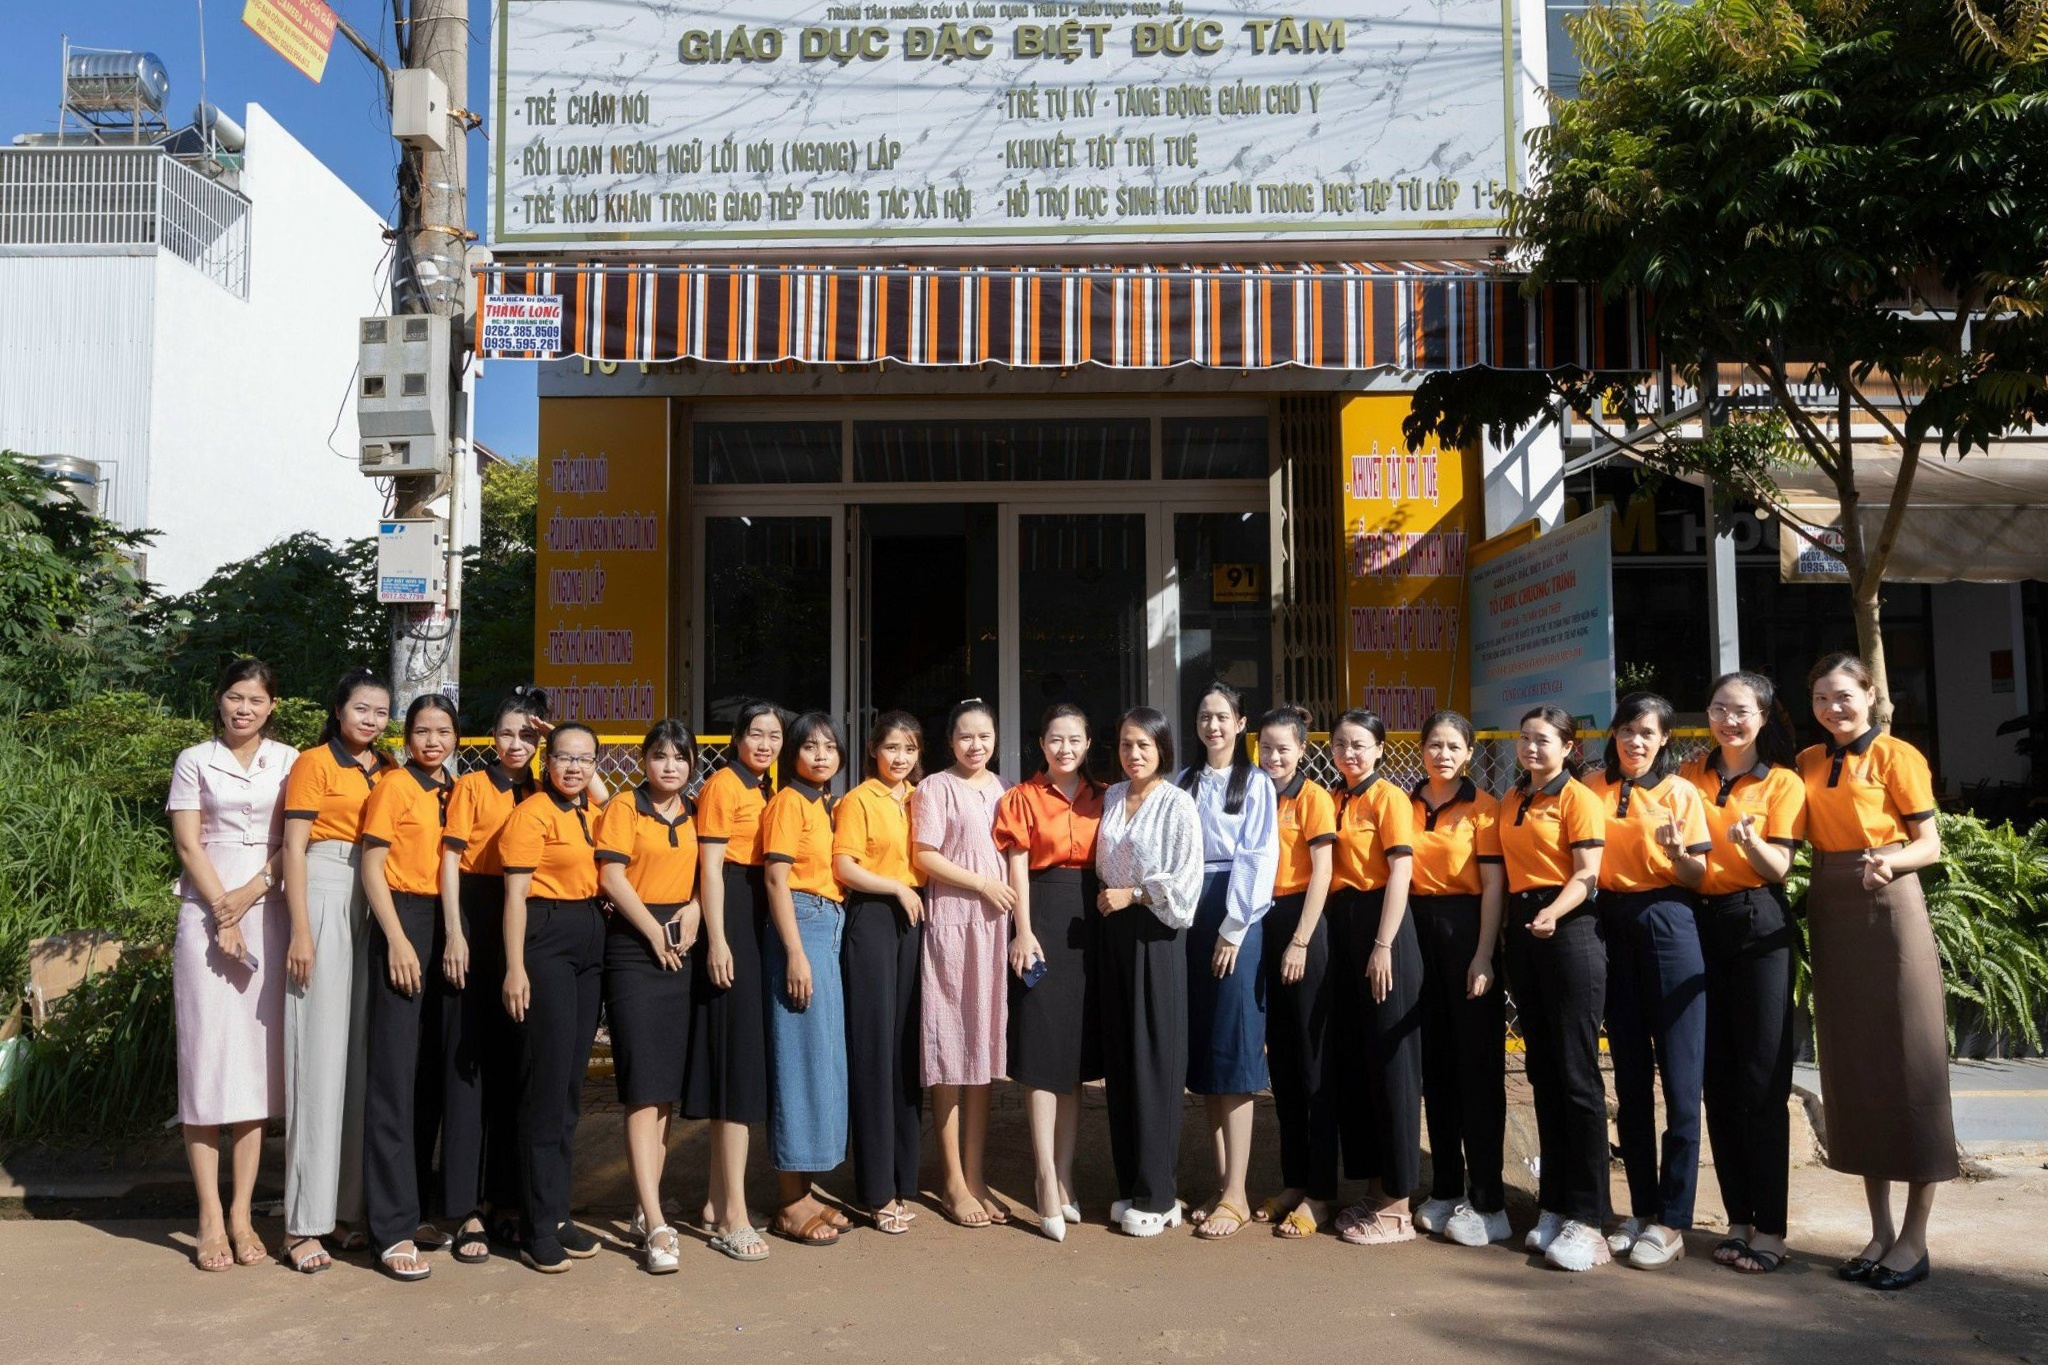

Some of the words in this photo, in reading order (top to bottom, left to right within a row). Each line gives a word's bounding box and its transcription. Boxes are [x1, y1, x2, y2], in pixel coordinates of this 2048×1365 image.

[303, 19, 314, 32] AN
[827, 5, 862, 21] TRUNG
[864, 4, 888, 20] TÂM
[890, 3, 929, 20] NGHIÊN
[930, 1, 953, 19] CỨU
[955, 2, 970, 19] VÀ
[1000, 4, 1029, 21] DỤNG
[1104, 3, 1129, 19] DỤC
[678, 24, 784, 65] GIÁO
[799, 26, 890, 68] DỤC
[903, 22, 994, 66] ĐẶC
[1013, 19, 1113, 65] BIỆT
[1131, 15, 1224, 58] ĐỨC
[1241, 15, 1346, 56] TÂM
[525, 88, 557, 126] TRẺ
[567, 90, 617, 127] CHẬM
[621, 90, 650, 125] NÓI
[1006, 79, 1040, 120] TRẺ
[1114, 83, 1161, 118] TĂNG
[1166, 83, 1213, 119] ĐỘNG
[1218, 77, 1262, 116] GIẢM
[1266, 80, 1302, 116] CHÚ
[1308, 80, 1322, 115] Ý
[523, 136, 552, 177] RỐI
[557, 144, 603, 178] LOẠN
[610, 140, 658, 176] NGÔN
[666, 137, 704, 175] NGỮ
[745, 138, 774, 174] NÓI
[782, 139, 858, 175] (NGỌNG)
[866, 133, 902, 172] LẮP
[1006, 129, 1077, 169] KHUYẾT
[1085, 133, 1118, 170] TẬT
[1124, 132, 1156, 168] TRÍ
[1163, 131, 1199, 169] TUỆ
[522, 185, 557, 224] TRẺ
[562, 188, 598, 224] KHÓ
[604, 189, 652, 224] KHĂN
[659, 190, 717, 223] TRONG
[722, 190, 763, 222] GIAO
[767, 182, 805, 222] TIẾP
[877, 186, 911, 220] TÁC
[913, 185, 939, 220] XÃ
[944, 186, 972, 222] HỘI
[1006, 179, 1031, 218] HỖ
[1035, 183, 1071, 221] TRỢ
[1074, 185, 1109, 220] HỌC
[1116, 185, 1159, 217] SINH
[1163, 179, 1201, 217] KHÓ
[1205, 180, 1254, 216] KHĂN
[1256, 181, 1316, 214] TRONG
[1322, 181, 1356, 216] HỌC
[1360, 177, 1394, 216] TẬP
[1397, 176, 1423, 211] TỪ
[1426, 175, 1462, 212] LỚP
[1471, 178, 1499, 210] 1-5
[485, 325, 559, 338] 0262.385.8509
[486, 303, 525, 318] THĂNG
[528, 305, 560, 318] LONG
[484, 337, 559, 350] 0935.595.261
[1634, 384, 1731, 415] GARAE
[552, 450, 569, 493] TRẺ
[568, 453, 592, 499] CHẬM
[593, 452, 609, 493] NÓI
[1351, 440, 1383, 499] KHUYẾT
[1386, 447, 1402, 507] TẬT
[1422, 447, 1439, 507] TUỆ
[564, 516, 587, 558] LOẠN
[586, 512, 609, 551] NGÔN
[642, 509, 658, 550] NÓI
[1405, 532, 1425, 578] SINH
[1424, 526, 1443, 578] KHÓ
[1227, 567, 1255, 588] 91
[549, 620, 565, 665] TRẺ
[565, 622, 582, 664] KHÓ
[582, 627, 606, 664] KHĂN
[606, 629, 634, 664] TRONG
[1350, 606, 1378, 651] TRONG
[1379, 606, 1396, 660] HỌC
[1397, 598, 1414, 660] TẬP
[563, 675, 581, 721] TIẾP
[610, 680, 627, 720] TÁC
[639, 679, 656, 727] HỘI
